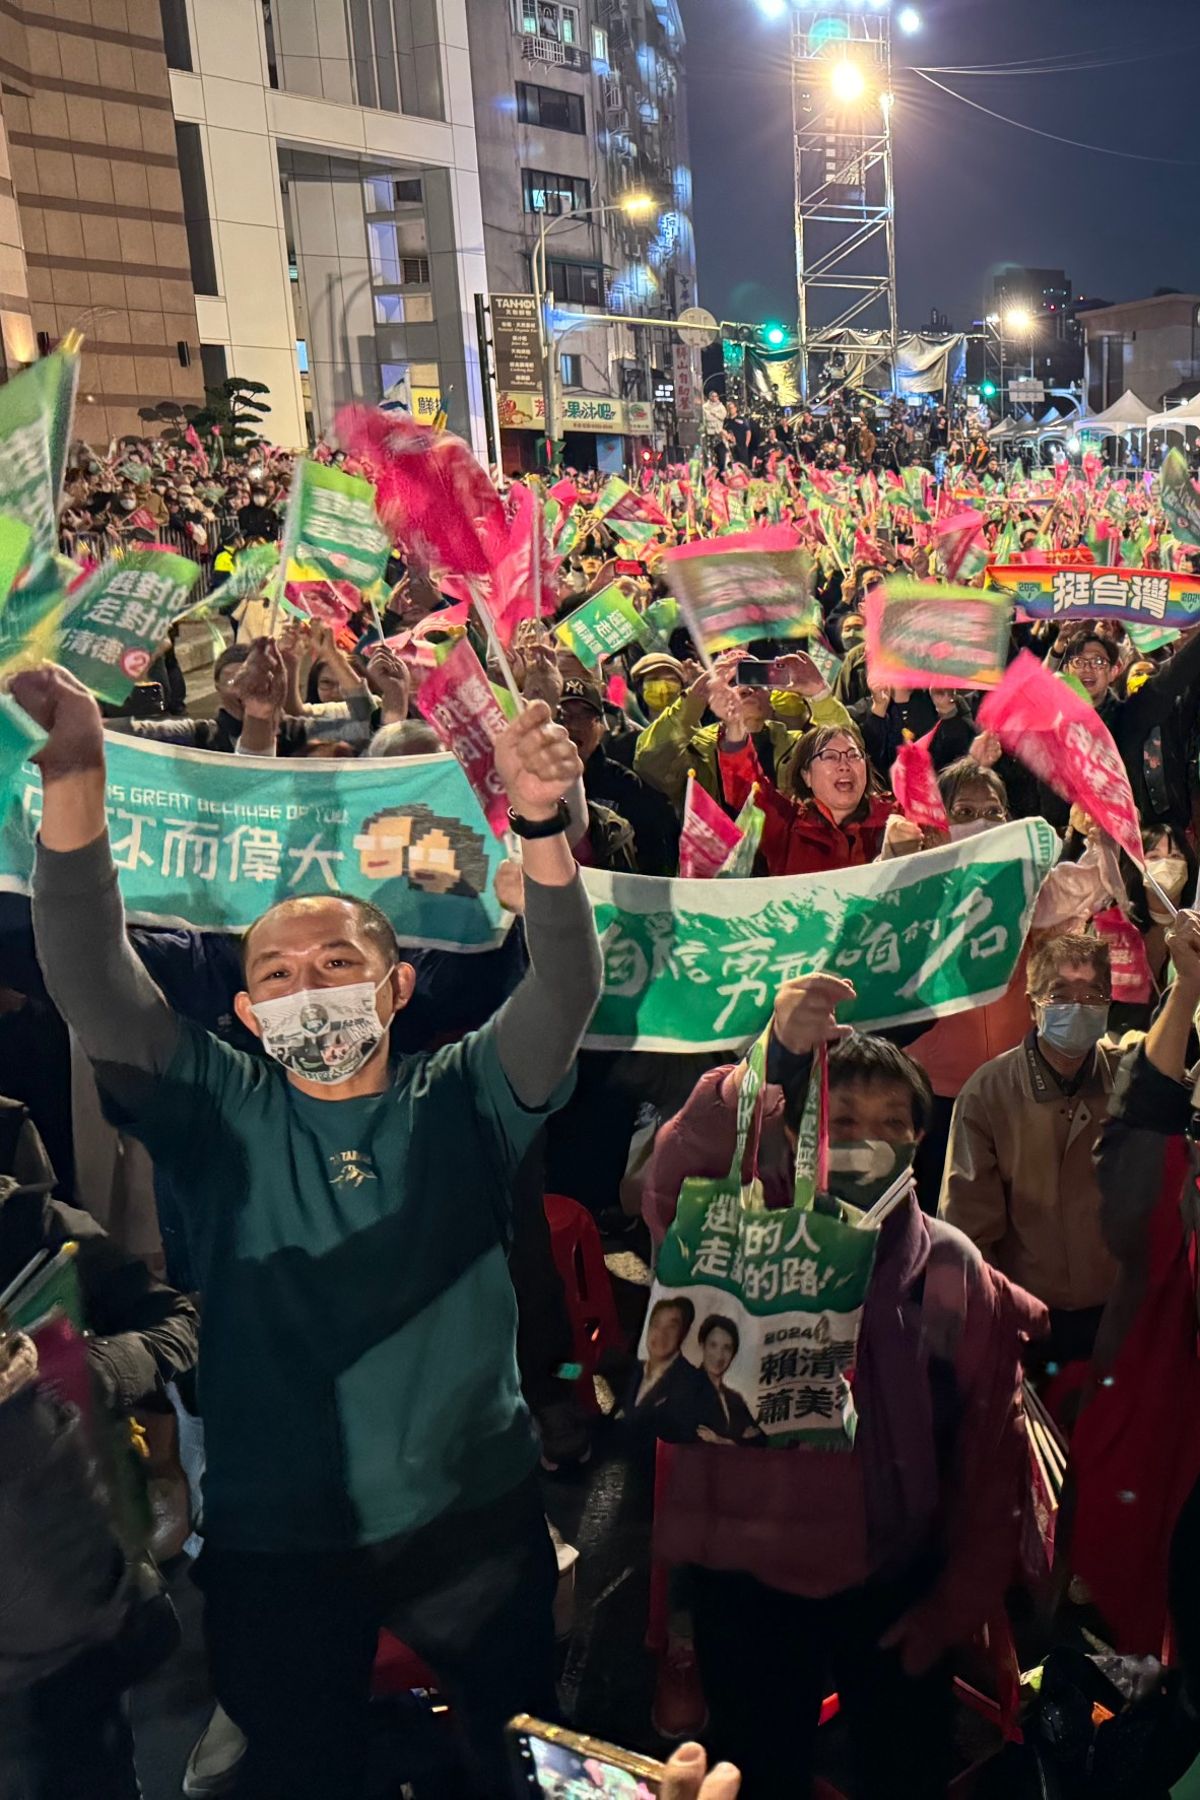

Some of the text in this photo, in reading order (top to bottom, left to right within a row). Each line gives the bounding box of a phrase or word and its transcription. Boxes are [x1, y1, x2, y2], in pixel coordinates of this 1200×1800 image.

[1052, 572, 1170, 620] 挺台灣
[130, 787, 193, 811] GREAT
[198, 797, 282, 819] BECAUSE
[764, 1326, 813, 1345] 2024
